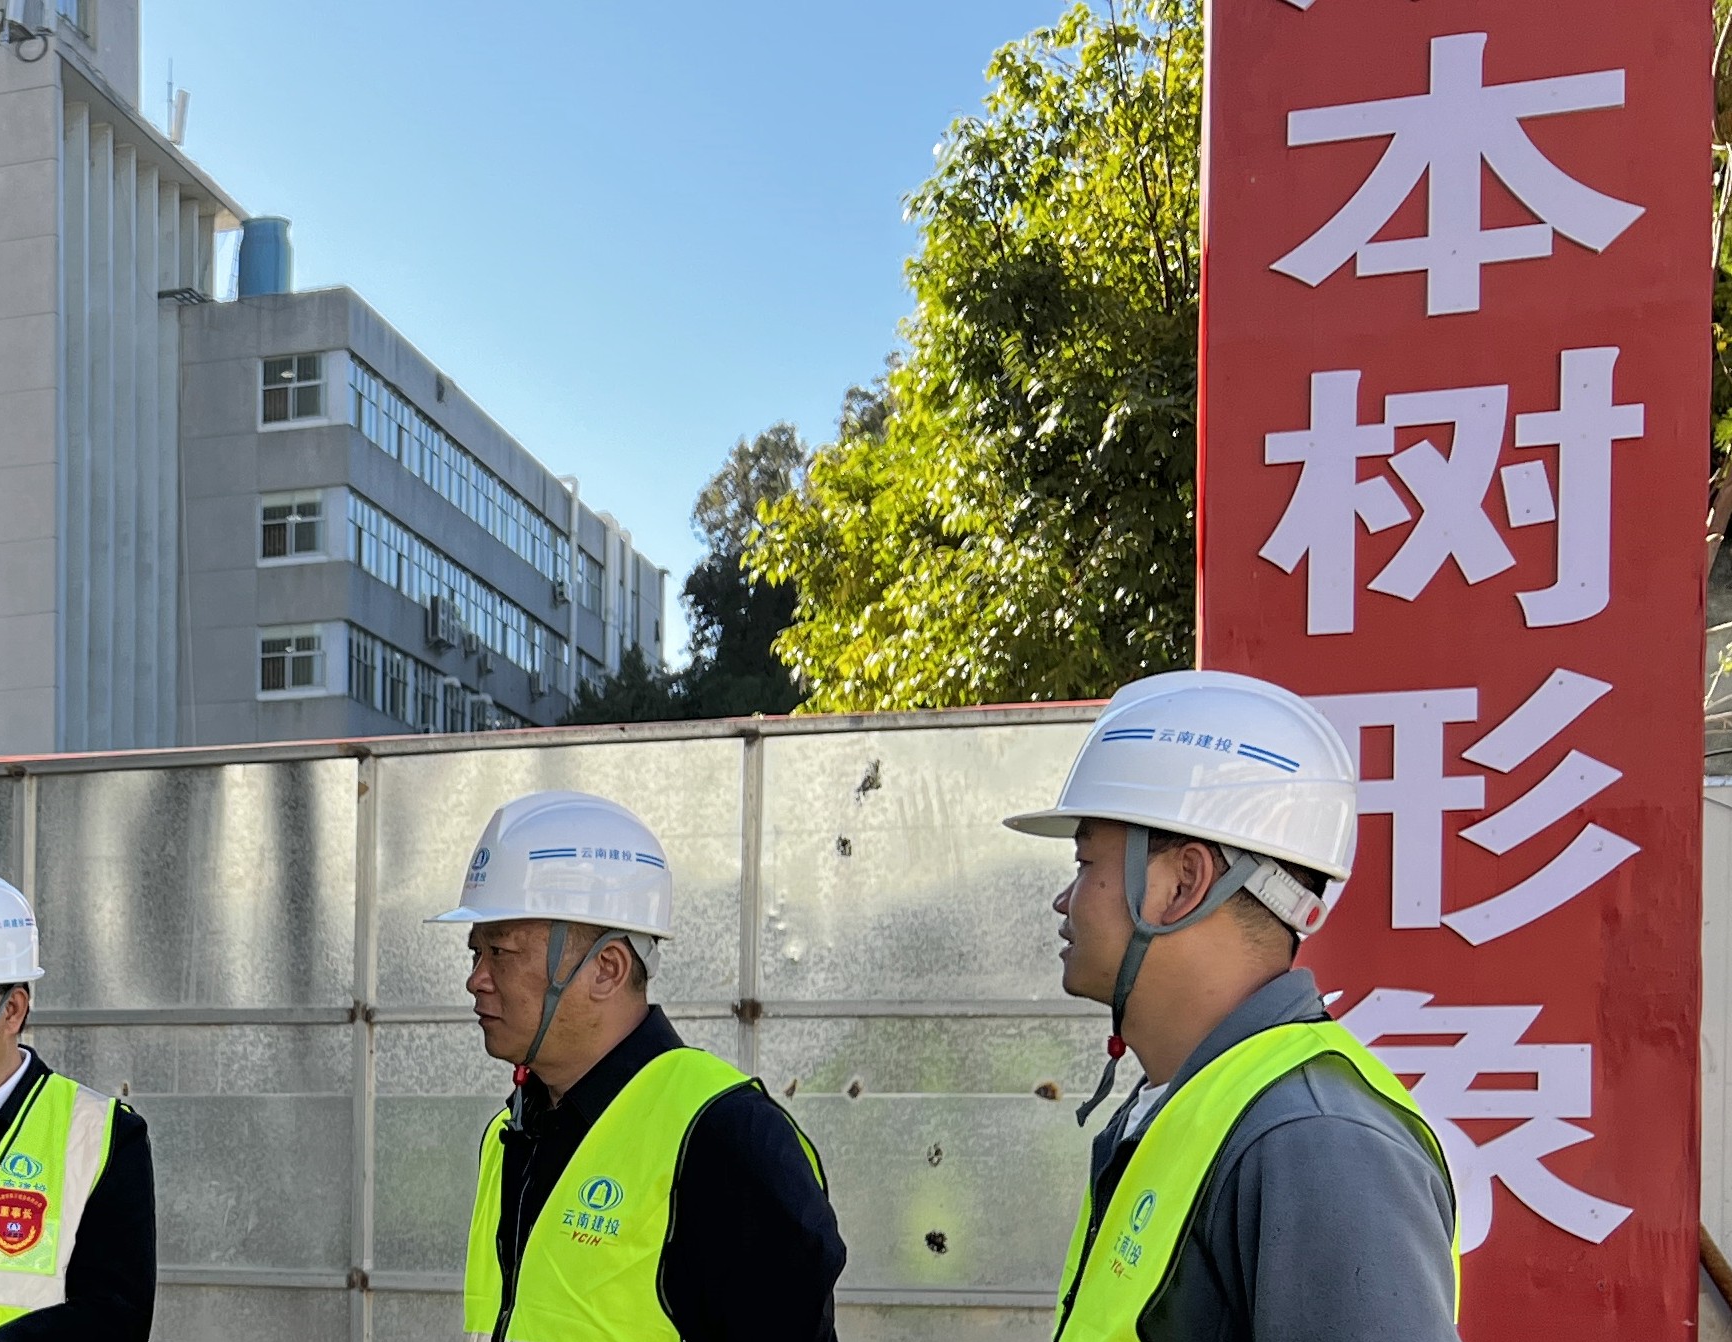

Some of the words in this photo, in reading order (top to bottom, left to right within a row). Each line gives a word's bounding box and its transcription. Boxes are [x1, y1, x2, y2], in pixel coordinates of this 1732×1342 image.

[1258, 0, 1646, 1255] 本树形象
[1158, 728, 1233, 754] 云南建投
[581, 847, 634, 862] 云南建投
[562, 1209, 621, 1236] 云南建投
[571, 1230, 602, 1247] YCIH
